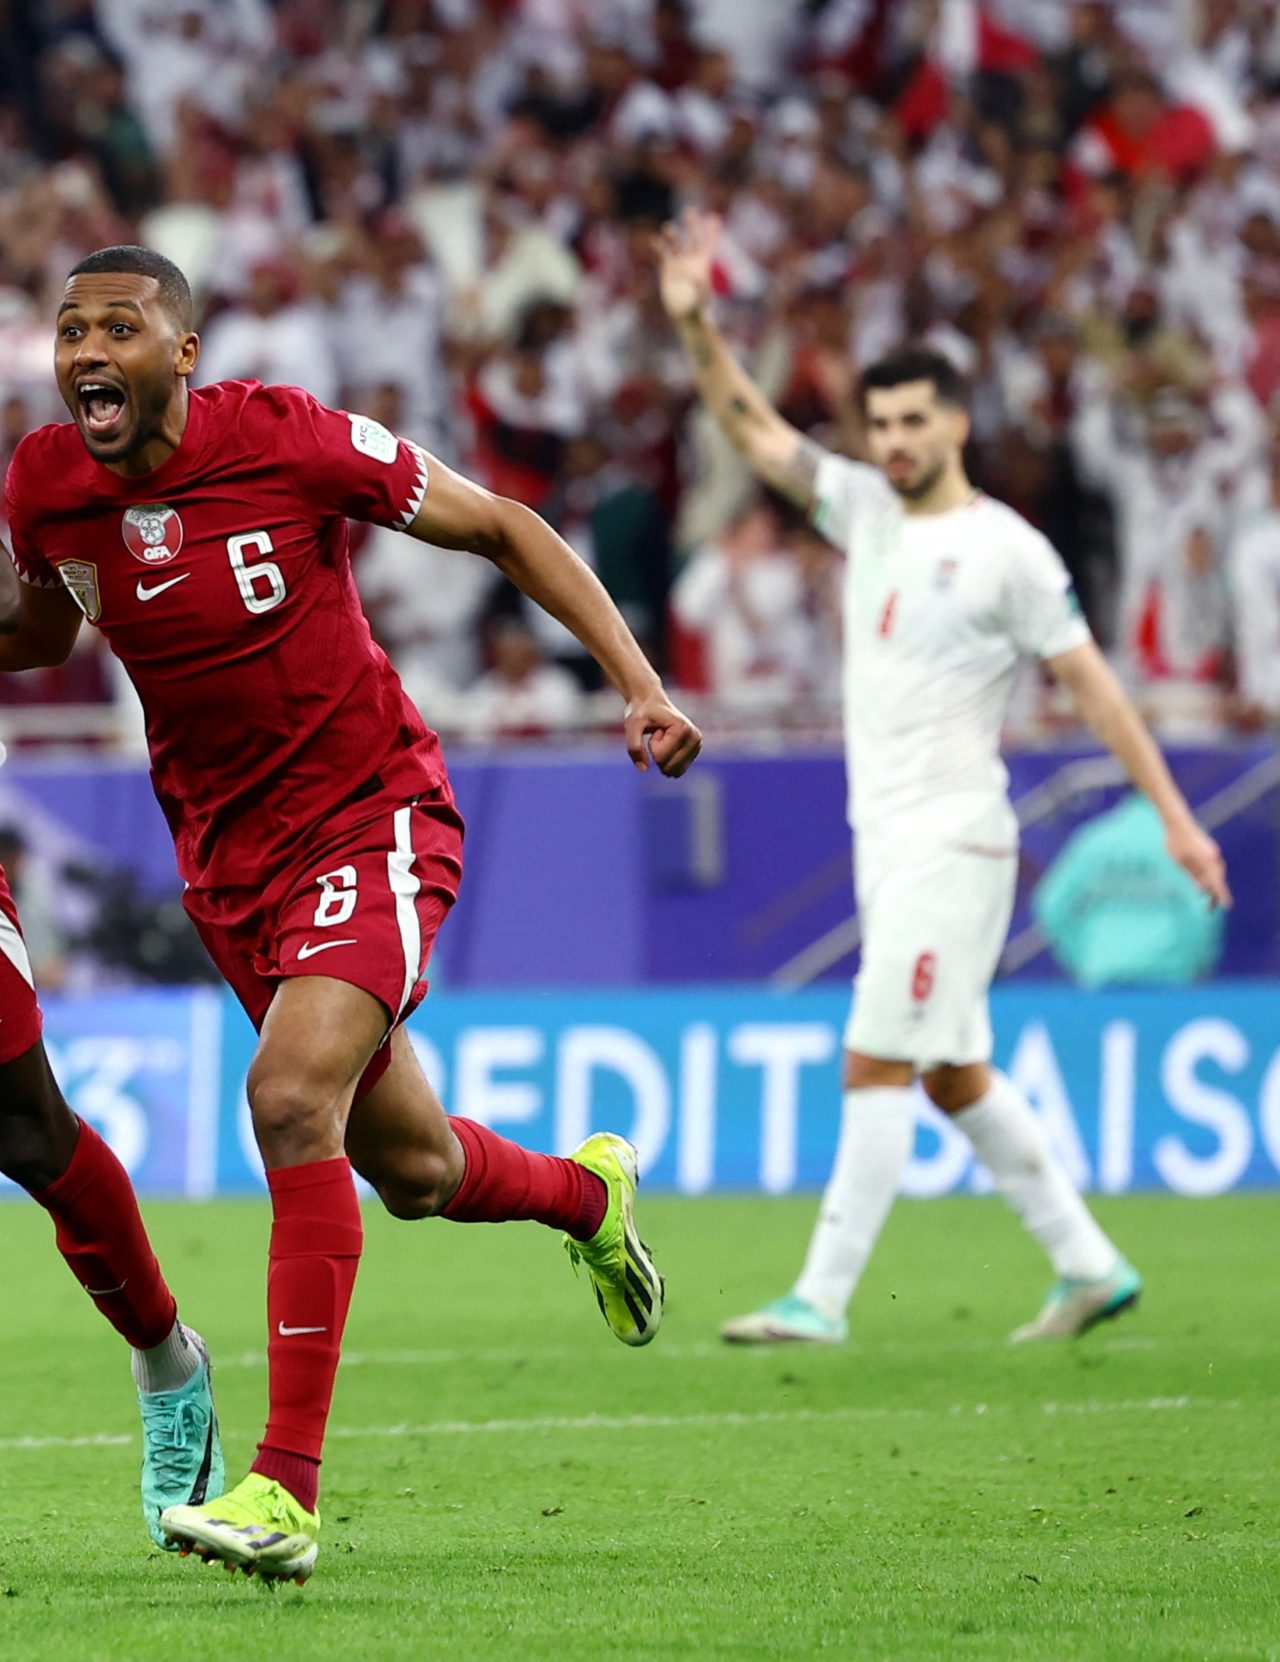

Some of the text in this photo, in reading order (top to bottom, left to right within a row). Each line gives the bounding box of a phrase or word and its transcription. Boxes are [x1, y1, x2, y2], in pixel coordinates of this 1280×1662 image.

[360, 425, 368, 445] AFC
[143, 545, 171, 560] QFA
[226, 529, 287, 614] 6
[909, 950, 937, 1003] 6
[237, 1020, 837, 1196] EDIT
